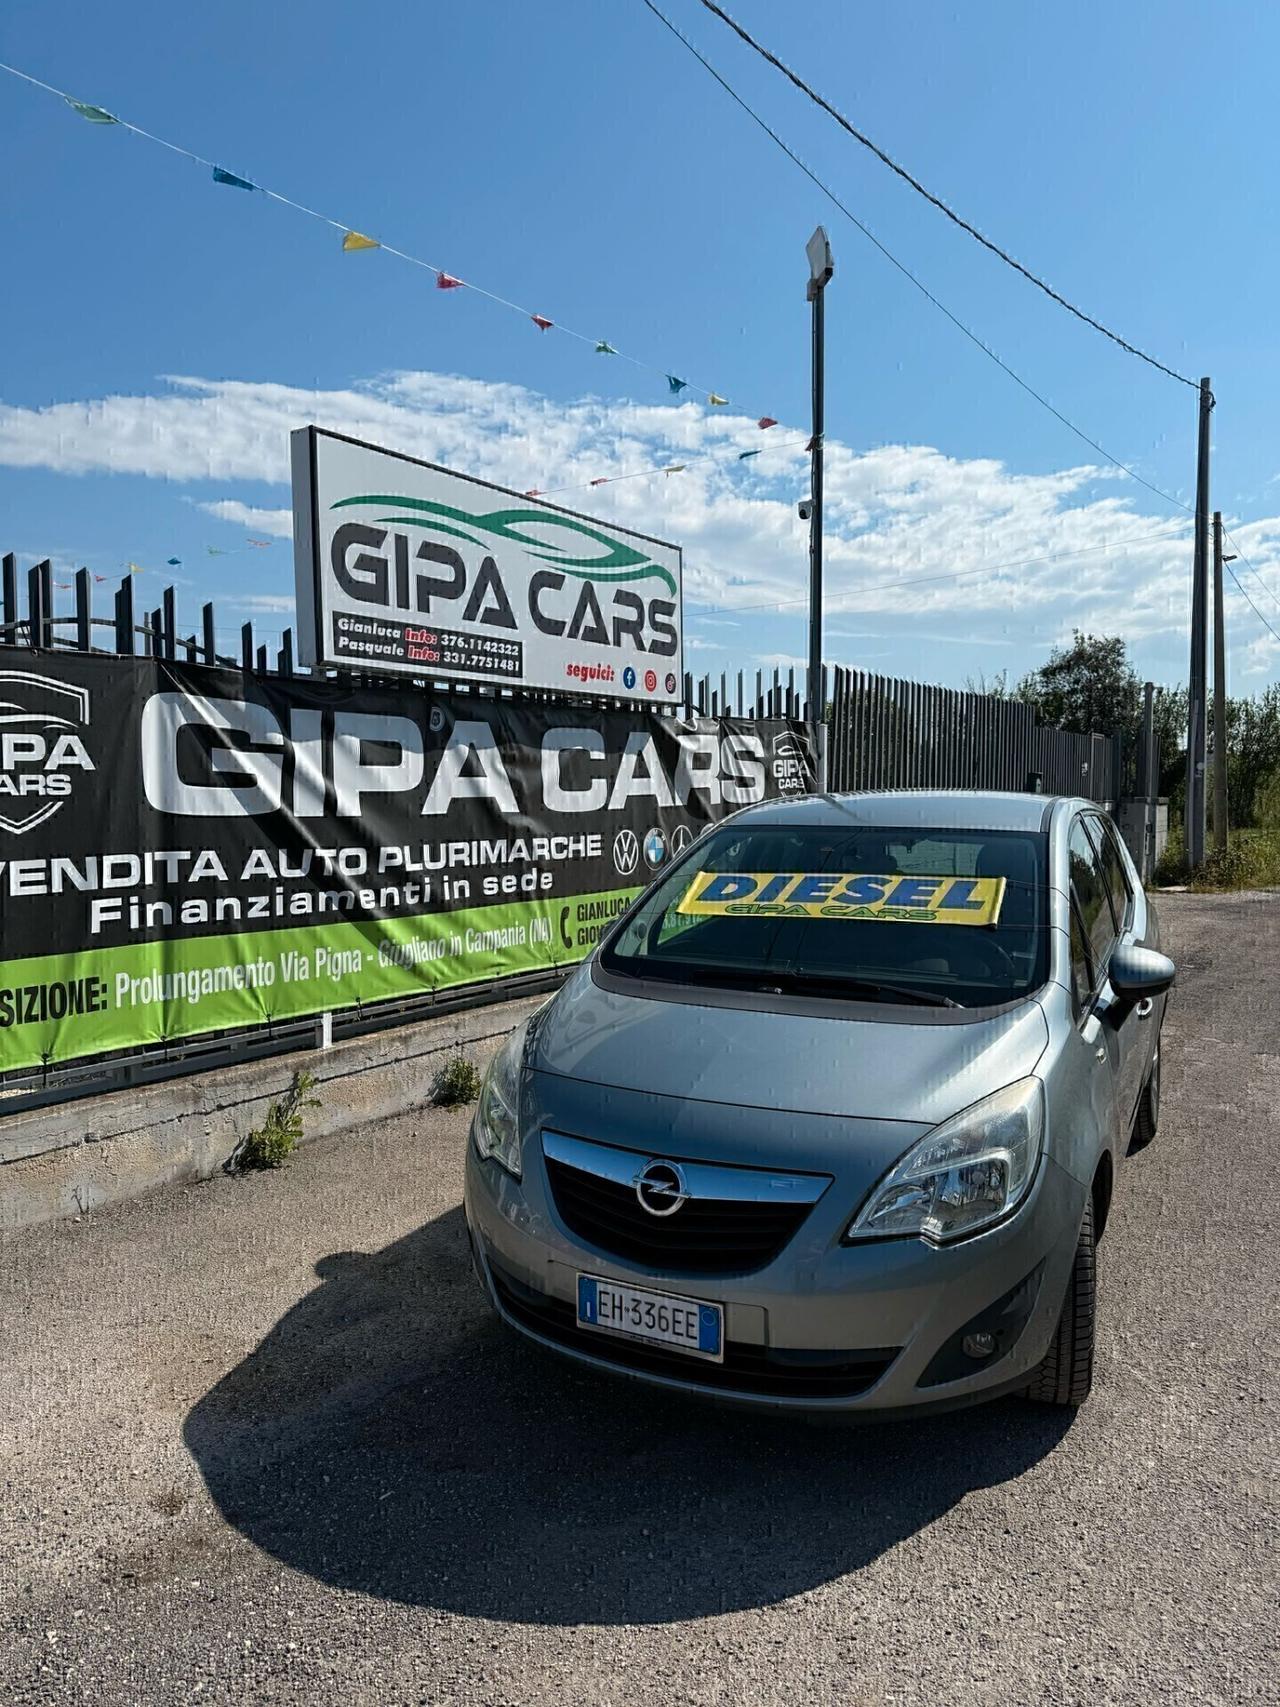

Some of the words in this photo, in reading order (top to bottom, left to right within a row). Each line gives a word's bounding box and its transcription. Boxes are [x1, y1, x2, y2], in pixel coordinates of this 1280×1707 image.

[330, 521, 518, 630] GIPA
[528, 569, 679, 658] CARS
[338, 618, 401, 638] Gianluca
[405, 628, 437, 645] Info:
[441, 634, 519, 656] 376.1142322
[338, 636, 404, 657] Pasquale
[408, 645, 440, 662] Info:
[443, 652, 519, 671] 331.7751481
[567, 663, 615, 682] seguici:
[141, 692, 520, 817] GIPA
[540, 727, 766, 813] CARS
[773, 759, 811, 778] GIPA
[0, 850, 228, 896] ENDITA
[240, 846, 367, 880] AUTO
[378, 834, 603, 874] PLURIMARCHE
[90, 874, 432, 934] Finanziamenti
[442, 877, 470, 902] in
[482, 868, 554, 894] sede
[576, 896, 631, 923] GIANLUCA
[695, 875, 986, 910] DIESEL
[724, 903, 811, 917] GIPA
[819, 905, 939, 922] CARS
[115, 956, 275, 1008] Prolungamento
[280, 950, 310, 983] Via
[315, 945, 362, 983] Pigna
[377, 935, 447, 971] Giugliano
[449, 930, 463, 957] in
[464, 920, 526, 955] Campania
[529, 916, 553, 949] (NA)
